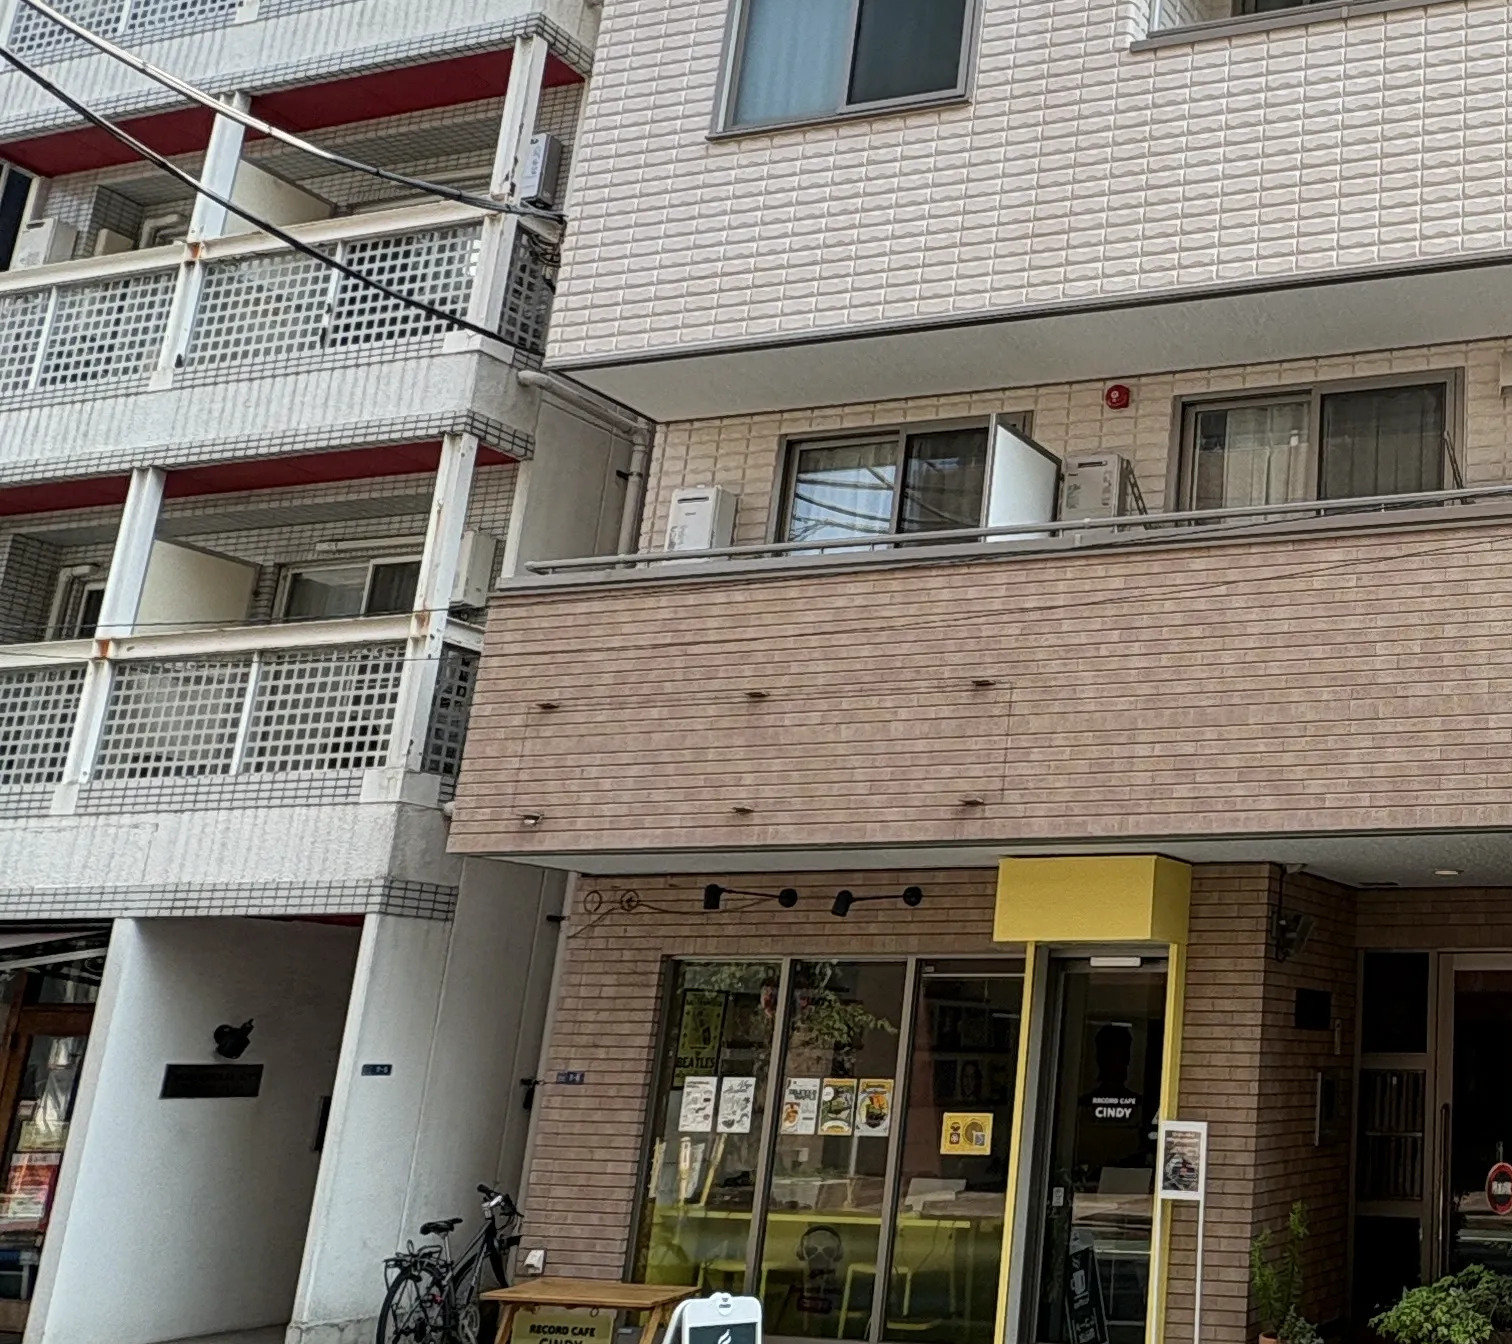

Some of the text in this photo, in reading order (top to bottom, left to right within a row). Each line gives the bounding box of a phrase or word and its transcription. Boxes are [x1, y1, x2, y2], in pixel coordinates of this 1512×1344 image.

[1095, 1107, 1132, 1118] CINDY
[529, 1324, 596, 1337] RECORD CAFE
